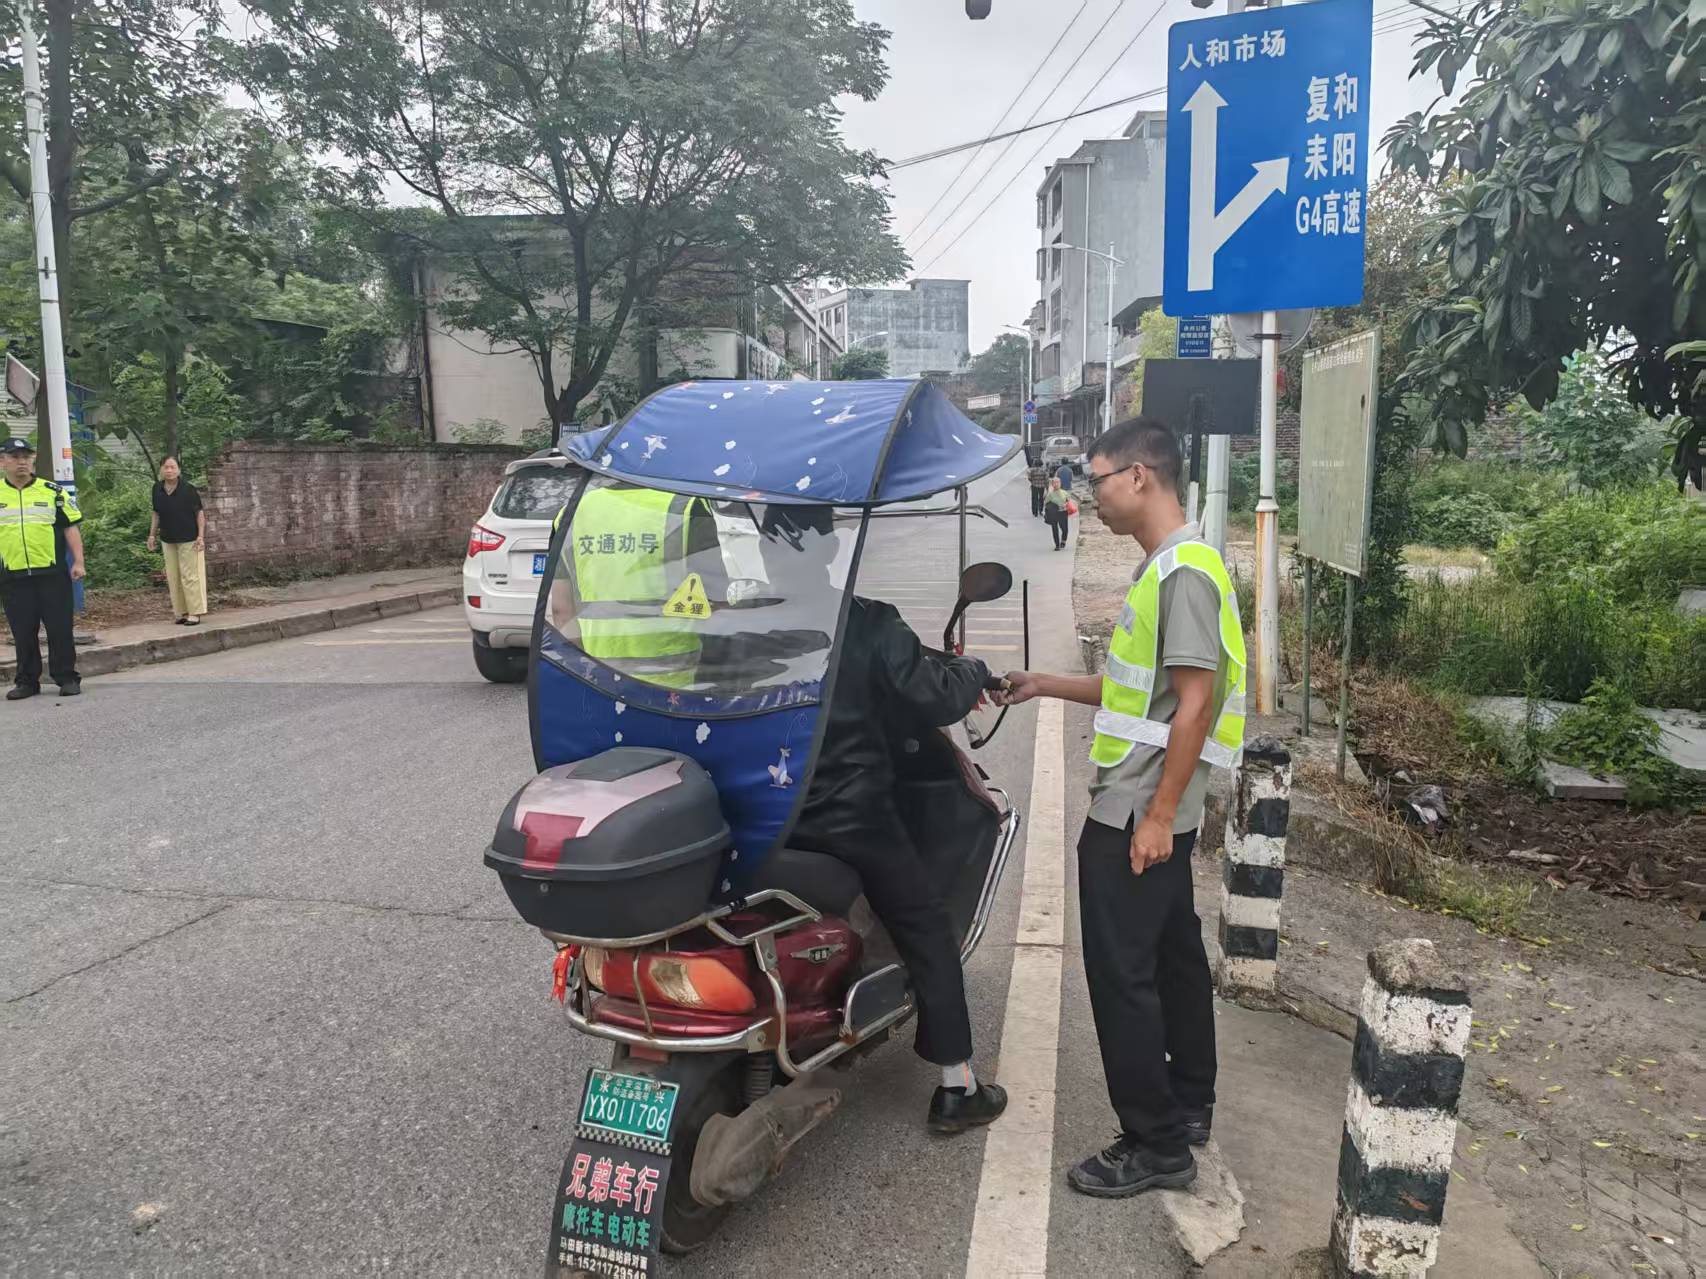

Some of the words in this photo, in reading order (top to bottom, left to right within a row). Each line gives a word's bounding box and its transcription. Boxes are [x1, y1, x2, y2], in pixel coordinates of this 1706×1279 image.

[1179, 29, 1286, 72] 人和市场
[1305, 72, 1358, 124] 复和
[1304, 132, 1356, 181] 耒阳
[1295, 188, 1361, 236] G4高速
[579, 532, 659, 555] 交通劝导
[589, 1093, 668, 1131] YX011706
[566, 1153, 659, 1214] 兄弟车行
[562, 1201, 604, 1239] 摩托车
[608, 1211, 650, 1250] 电动车
